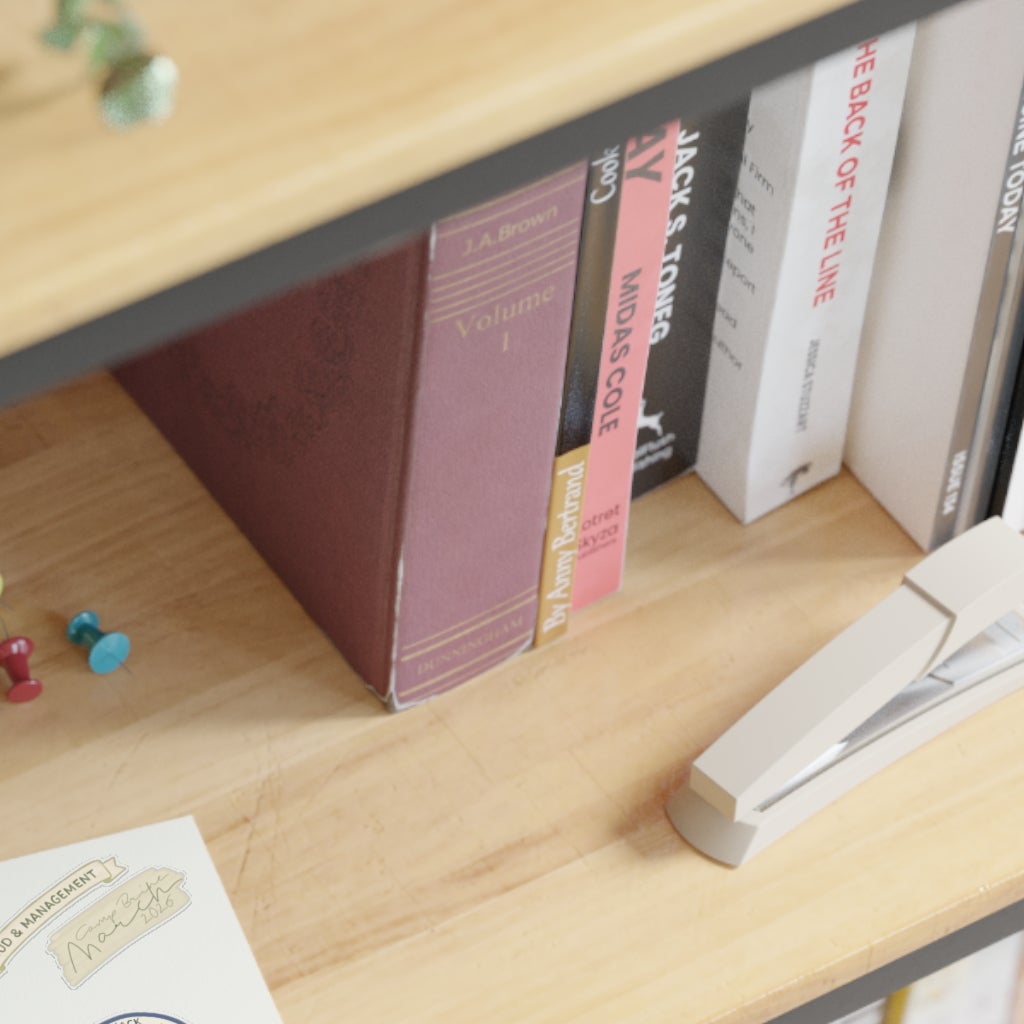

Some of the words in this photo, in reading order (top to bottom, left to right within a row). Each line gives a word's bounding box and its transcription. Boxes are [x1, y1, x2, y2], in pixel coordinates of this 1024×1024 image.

[841, 78, 872, 154] BACK
[669, 129, 700, 205] JACK
[834, 157, 859, 191] OF
[823, 195, 852, 250] THE
[455, 285, 556, 339] Volume
[813, 250, 842, 309] LINE
[609, 267, 642, 364] MIDAS
[598, 367, 626, 438] COLE
[551, 460, 585, 551] Bertrand
[542, 602, 571, 633] By
[10, 927, 23, 938] &
[20, 868, 97, 929] MANAGEMENT
[67, 878, 184, 973] March
[141, 893, 174, 924] 2026
